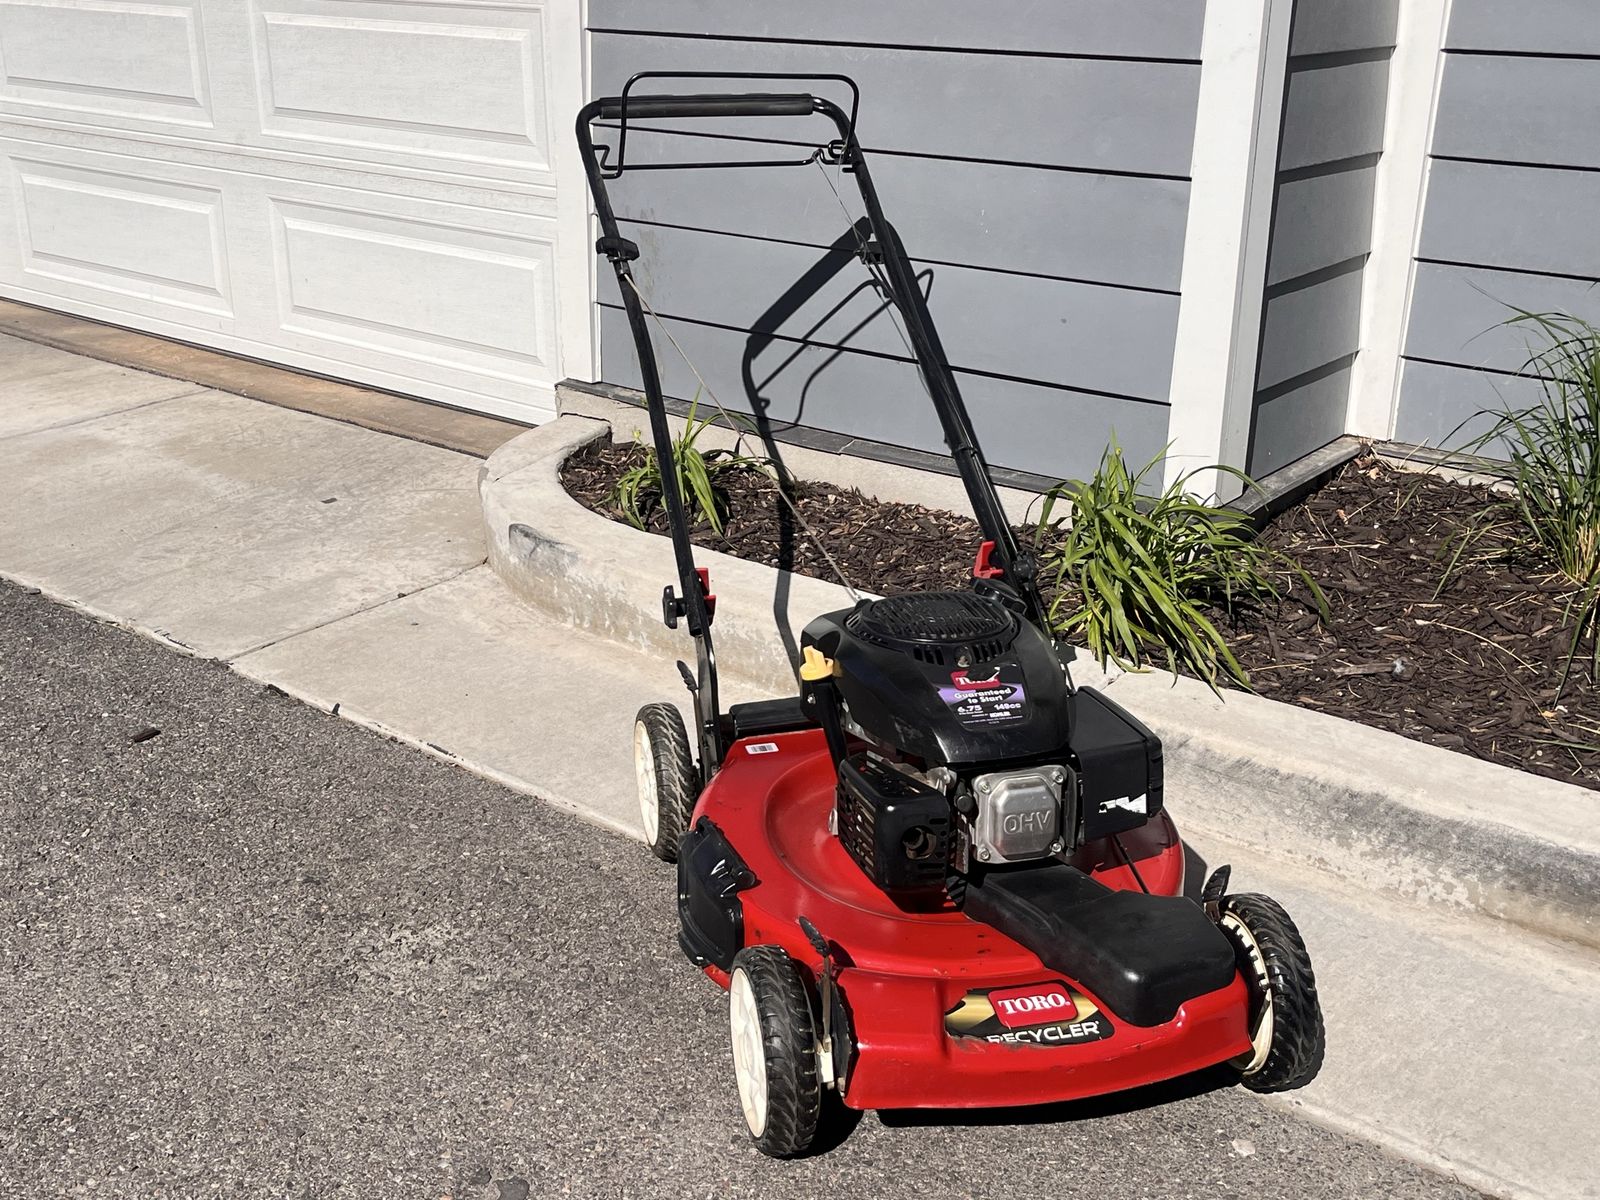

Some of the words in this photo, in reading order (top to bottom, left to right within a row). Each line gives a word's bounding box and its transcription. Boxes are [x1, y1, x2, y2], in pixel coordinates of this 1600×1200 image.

[954, 688, 1011, 699] Guaranteed
[980, 695, 1003, 703] Start
[957, 705, 982, 713] 6.75
[1003, 810, 1051, 835] OHV
